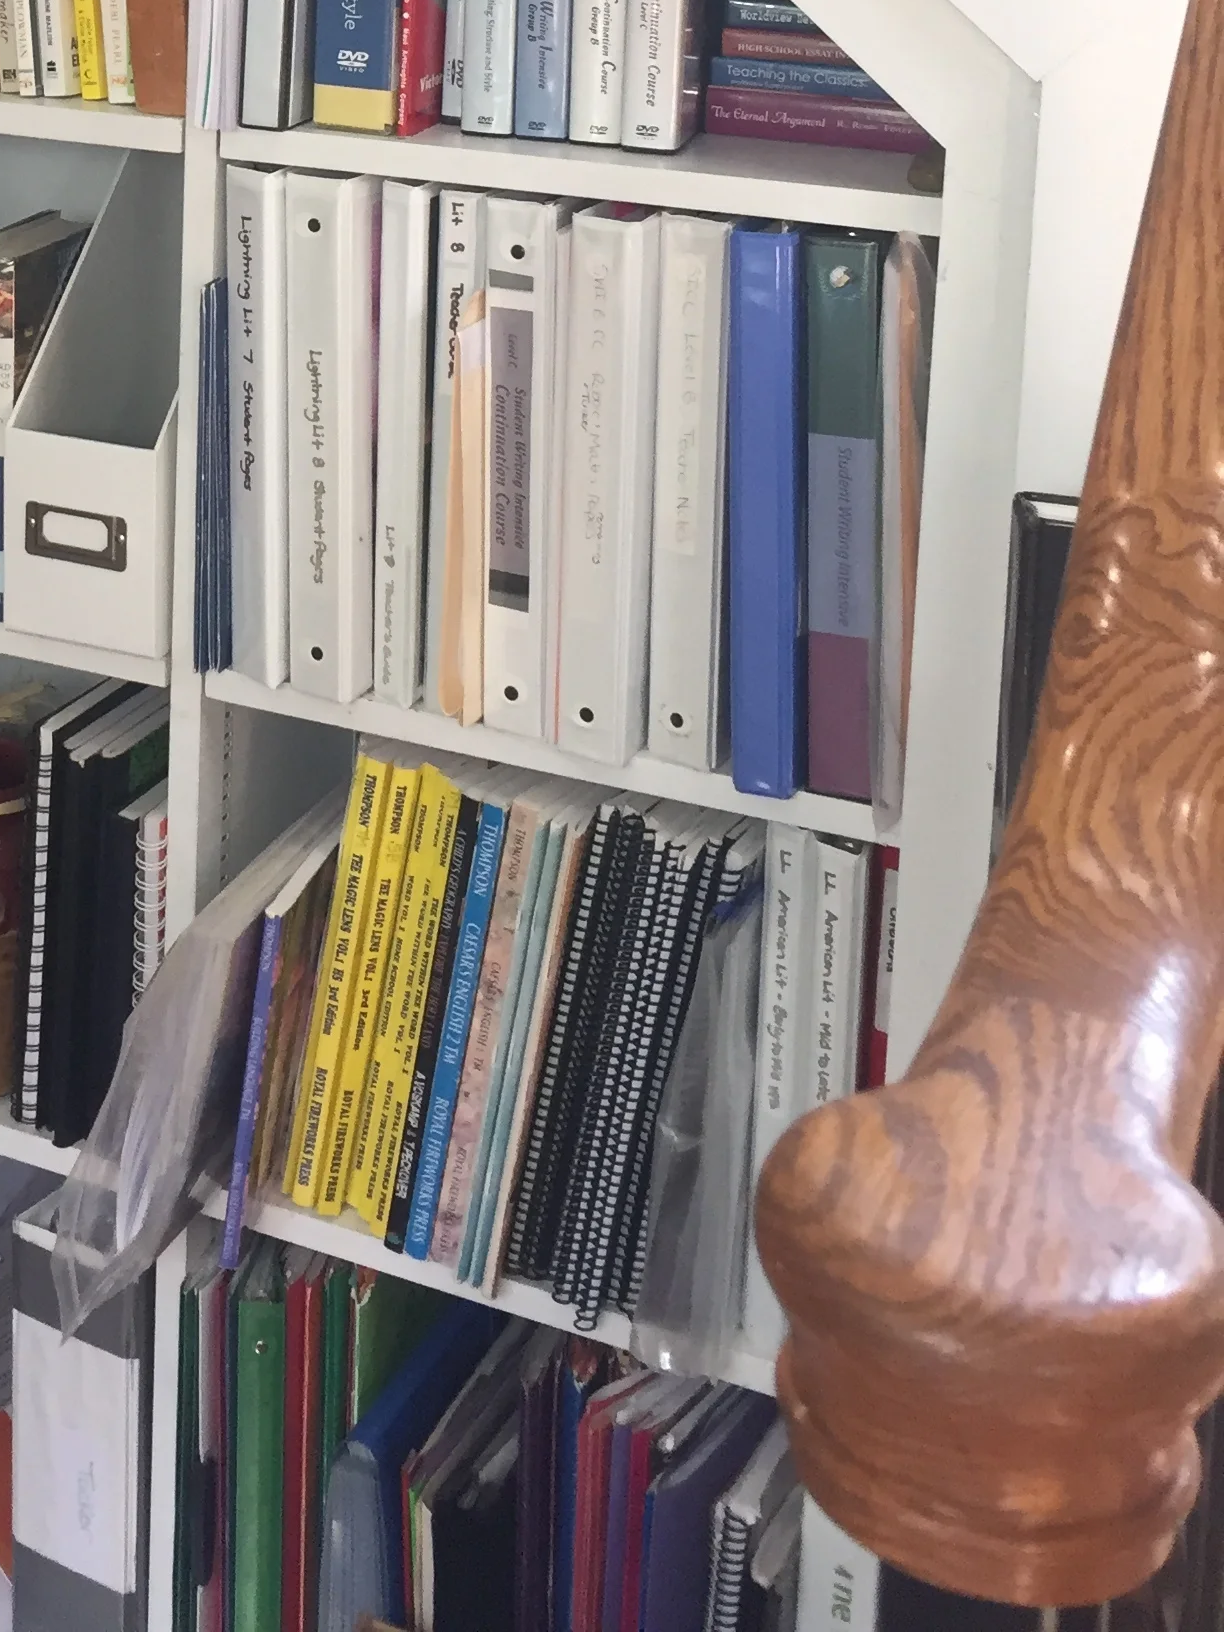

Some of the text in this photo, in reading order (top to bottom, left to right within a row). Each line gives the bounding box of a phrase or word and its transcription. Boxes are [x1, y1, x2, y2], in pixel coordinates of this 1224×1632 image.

[335, 48, 370, 66] DVD
[600, 60, 617, 96] Course
[727, 64, 786, 83] Teaching
[789, 70, 811, 83] the
[644, 62, 662, 108] Course
[450, 202, 465, 253] Lit 8
[237, 215, 253, 300] Lightning
[493, 383, 511, 548] Continuation Course
[358, 773, 378, 827] THOMPSON
[351, 853, 364, 870] THE
[345, 871, 360, 907] MAGIC
[451, 823, 500, 1031] THOMPSON ENGLISH
[297, 1067, 328, 1187] ROYAL FIREWORKS PRESS
[411, 1095, 450, 1245] ROYAL FIREWORKS PRESS
